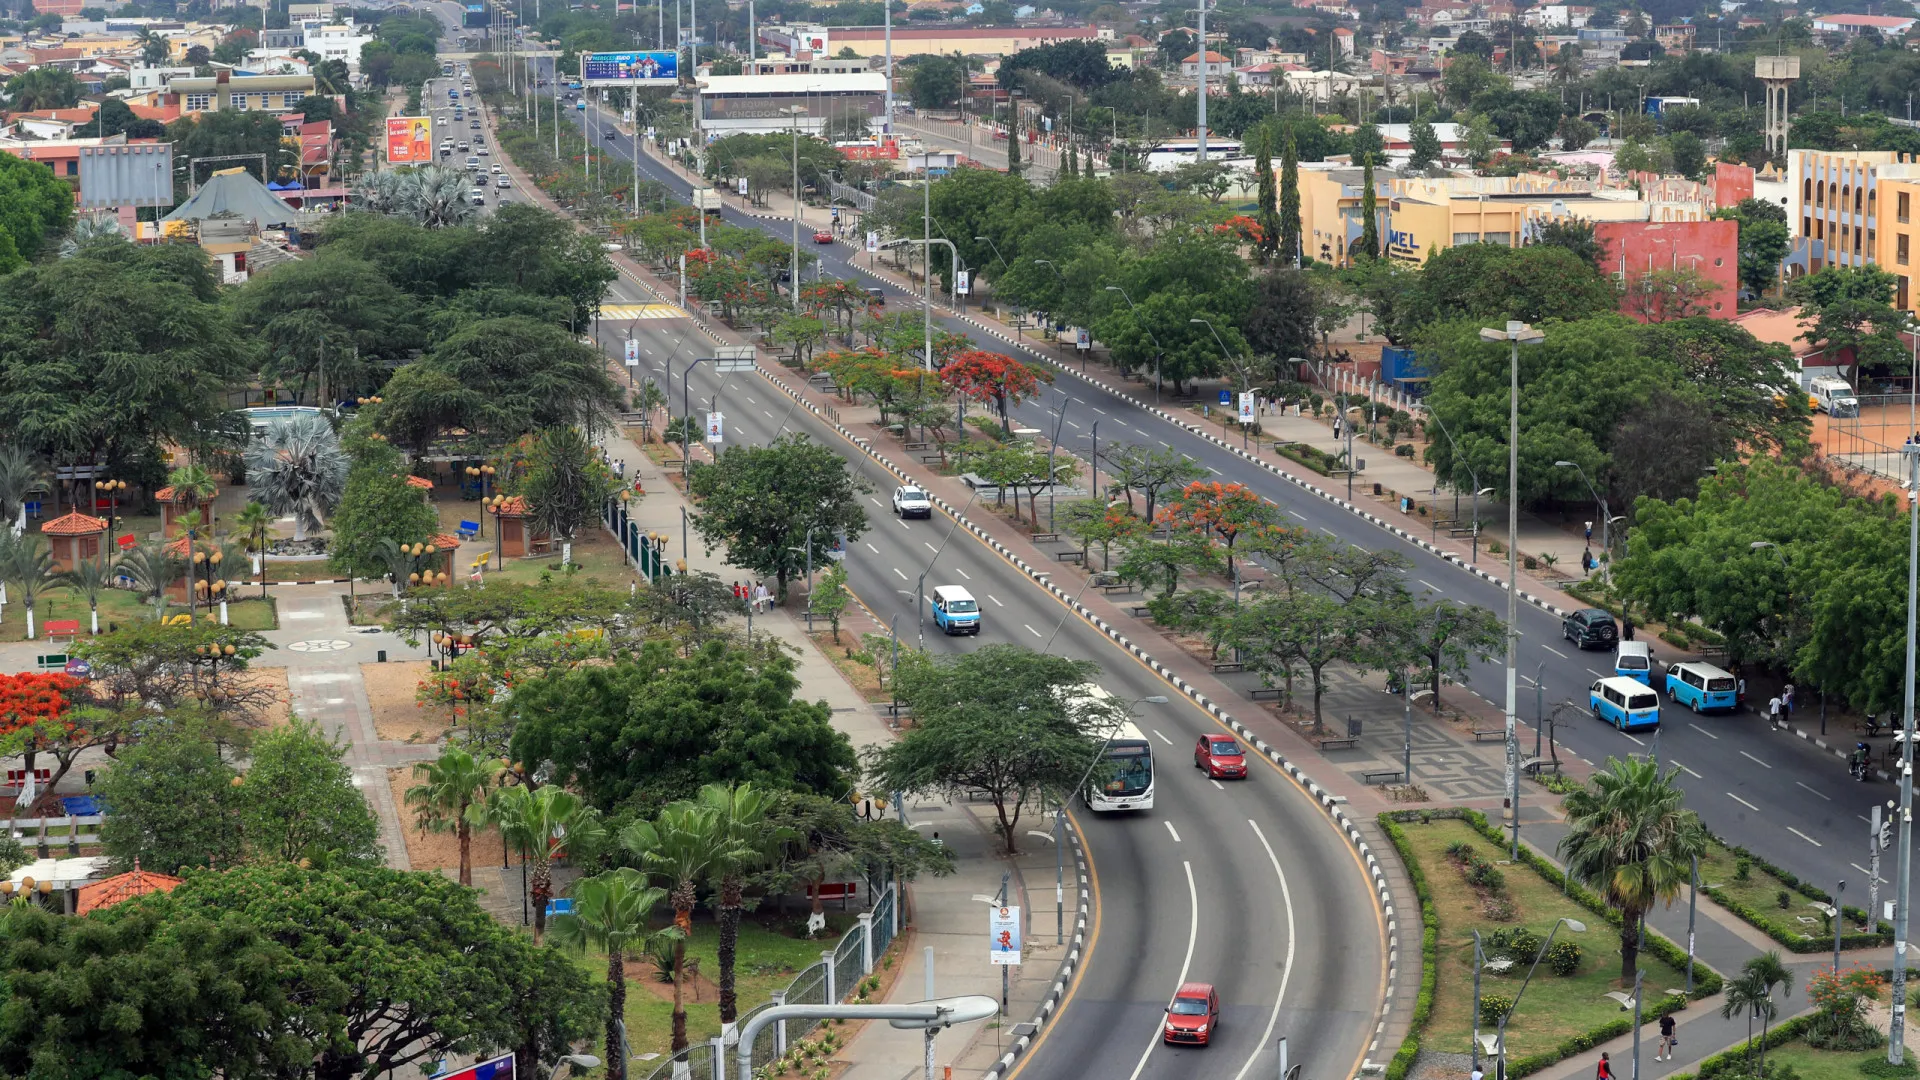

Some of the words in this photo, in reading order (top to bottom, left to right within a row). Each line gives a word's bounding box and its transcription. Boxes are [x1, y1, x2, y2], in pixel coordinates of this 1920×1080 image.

[732, 101, 739, 110] A
[742, 101, 776, 110] EQUIPA
[726, 110, 783, 118] VENCEDORA
